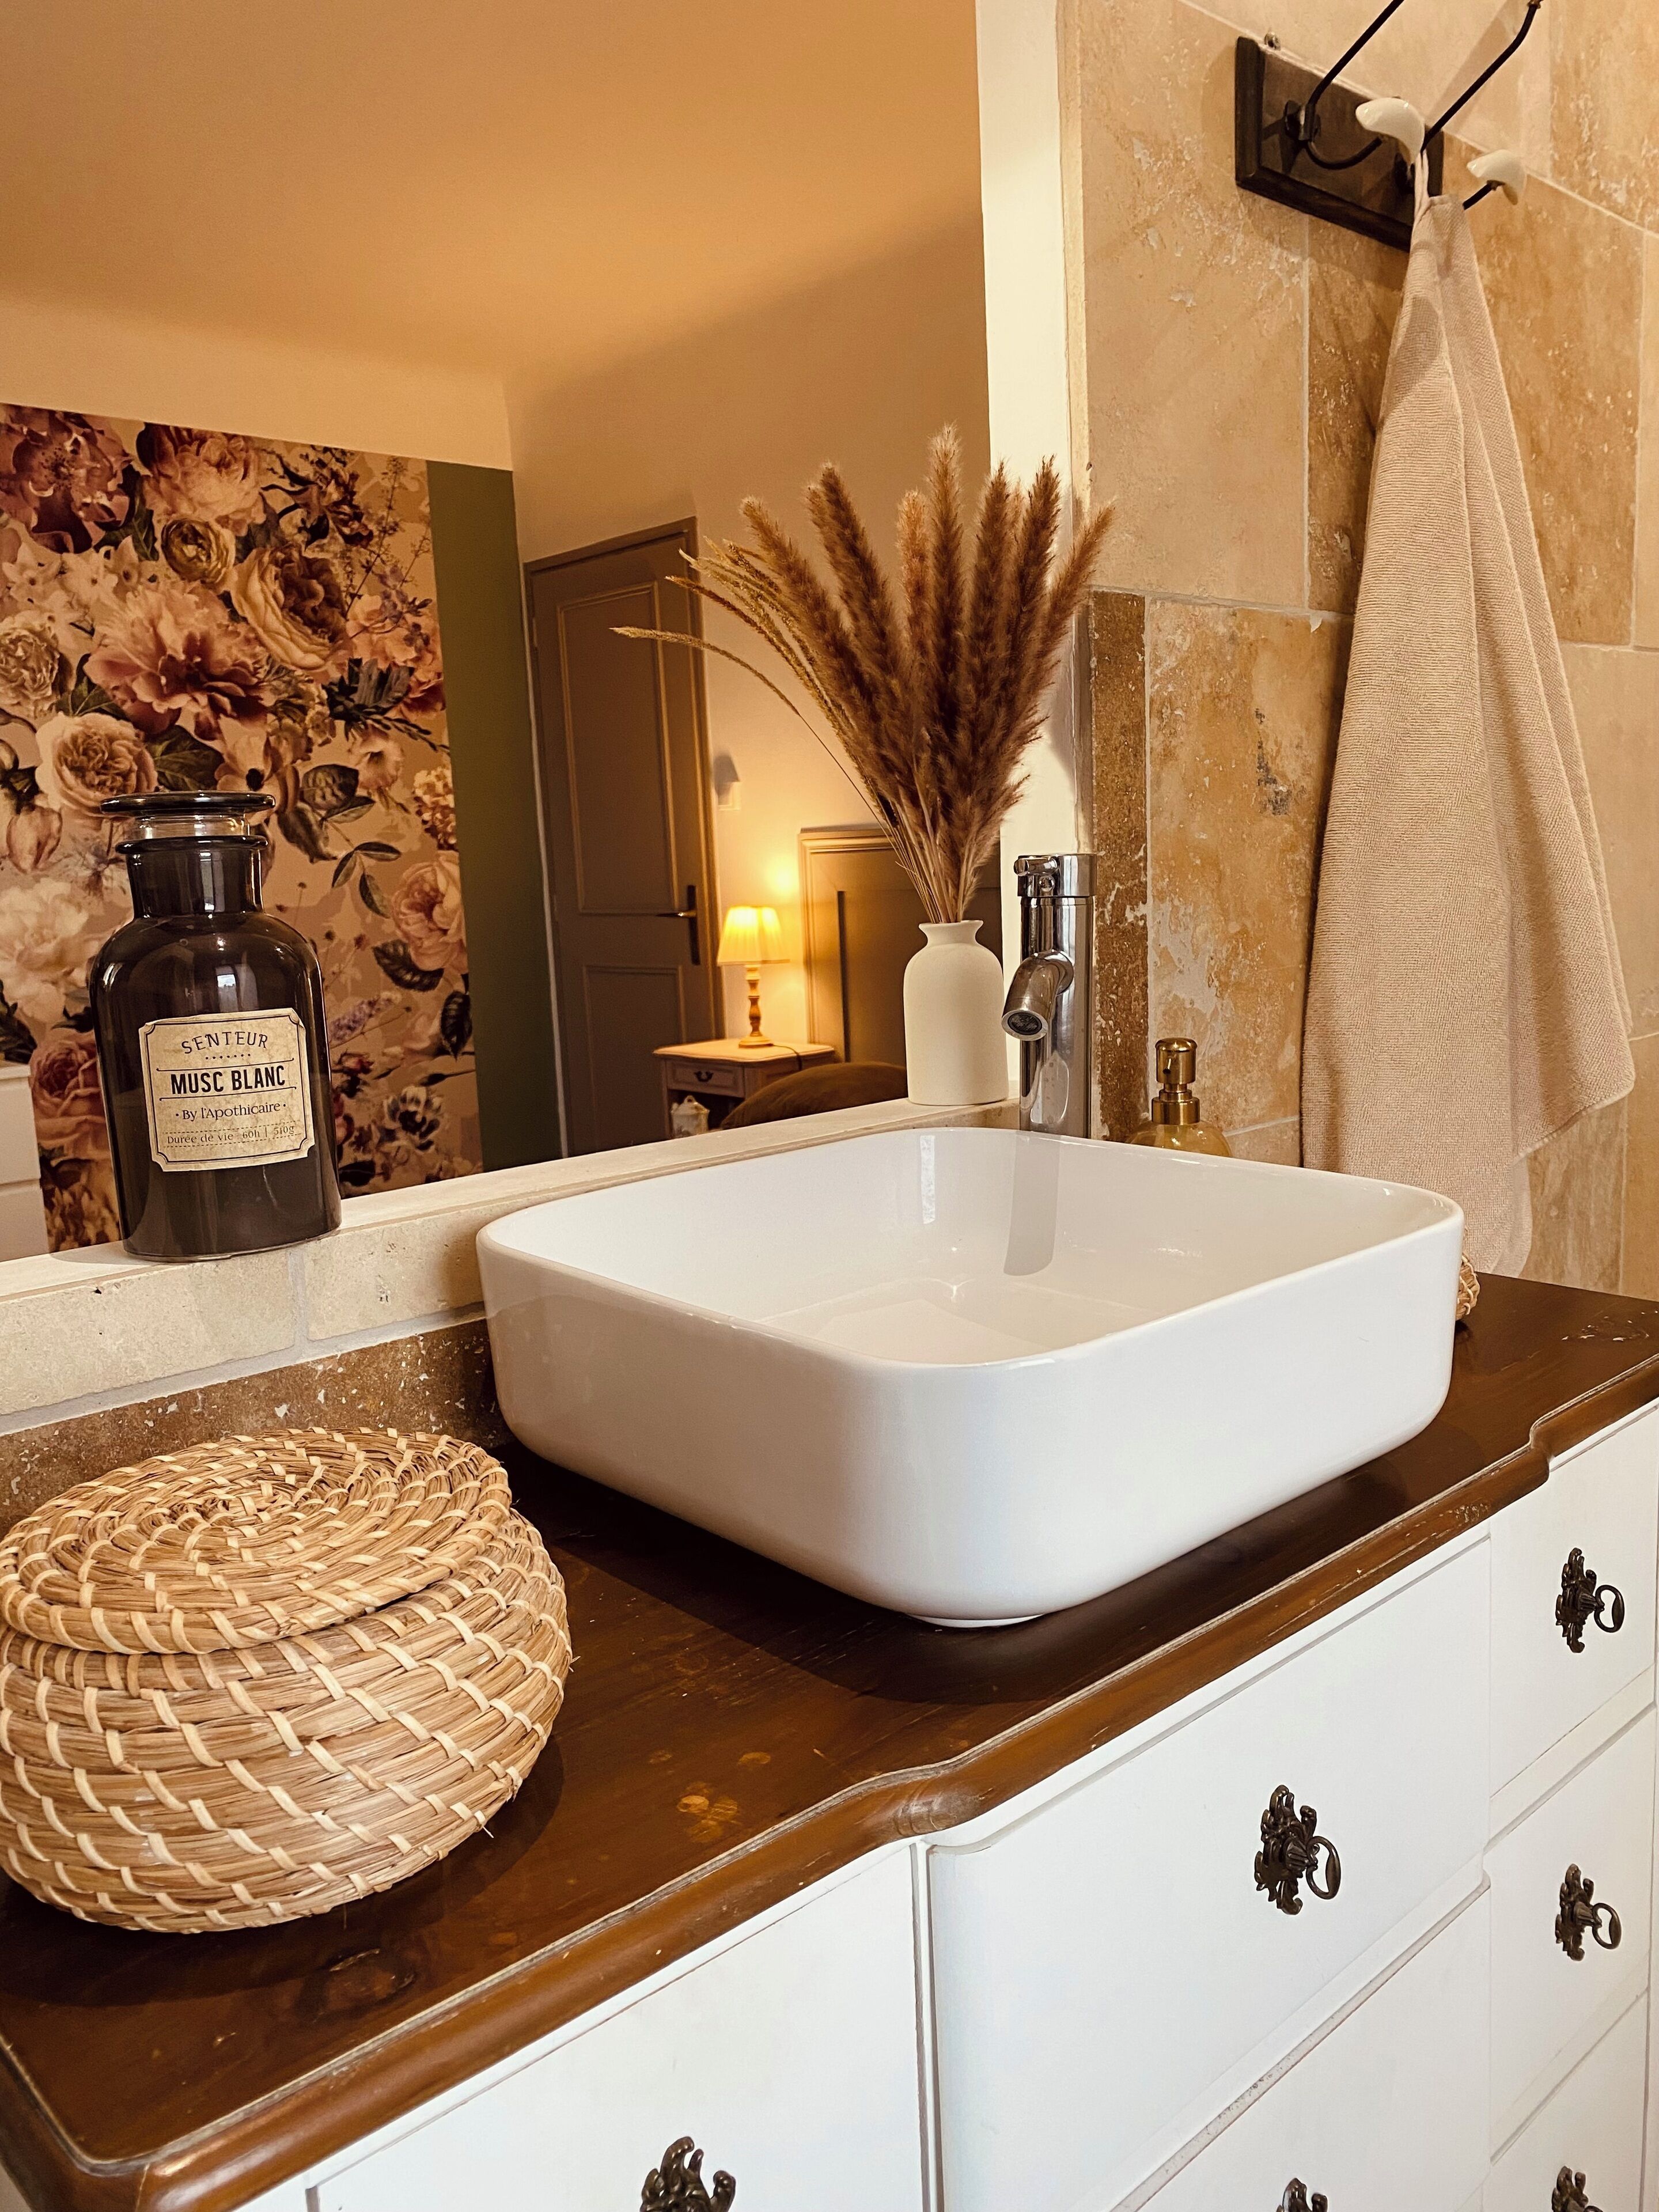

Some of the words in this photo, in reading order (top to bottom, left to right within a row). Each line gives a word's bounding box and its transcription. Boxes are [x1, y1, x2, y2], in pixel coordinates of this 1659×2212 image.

[181, 1031, 268, 1054] SENTEUR
[170, 1071, 224, 1094] MUSC
[231, 1065, 286, 1091] BLANC
[182, 1109, 197, 1122] By
[167, 1135, 197, 1144] Durée
[218, 1132, 233, 1142] vie
[242, 1129, 260, 1139] 60h
[273, 1125, 294, 1136] 510g
